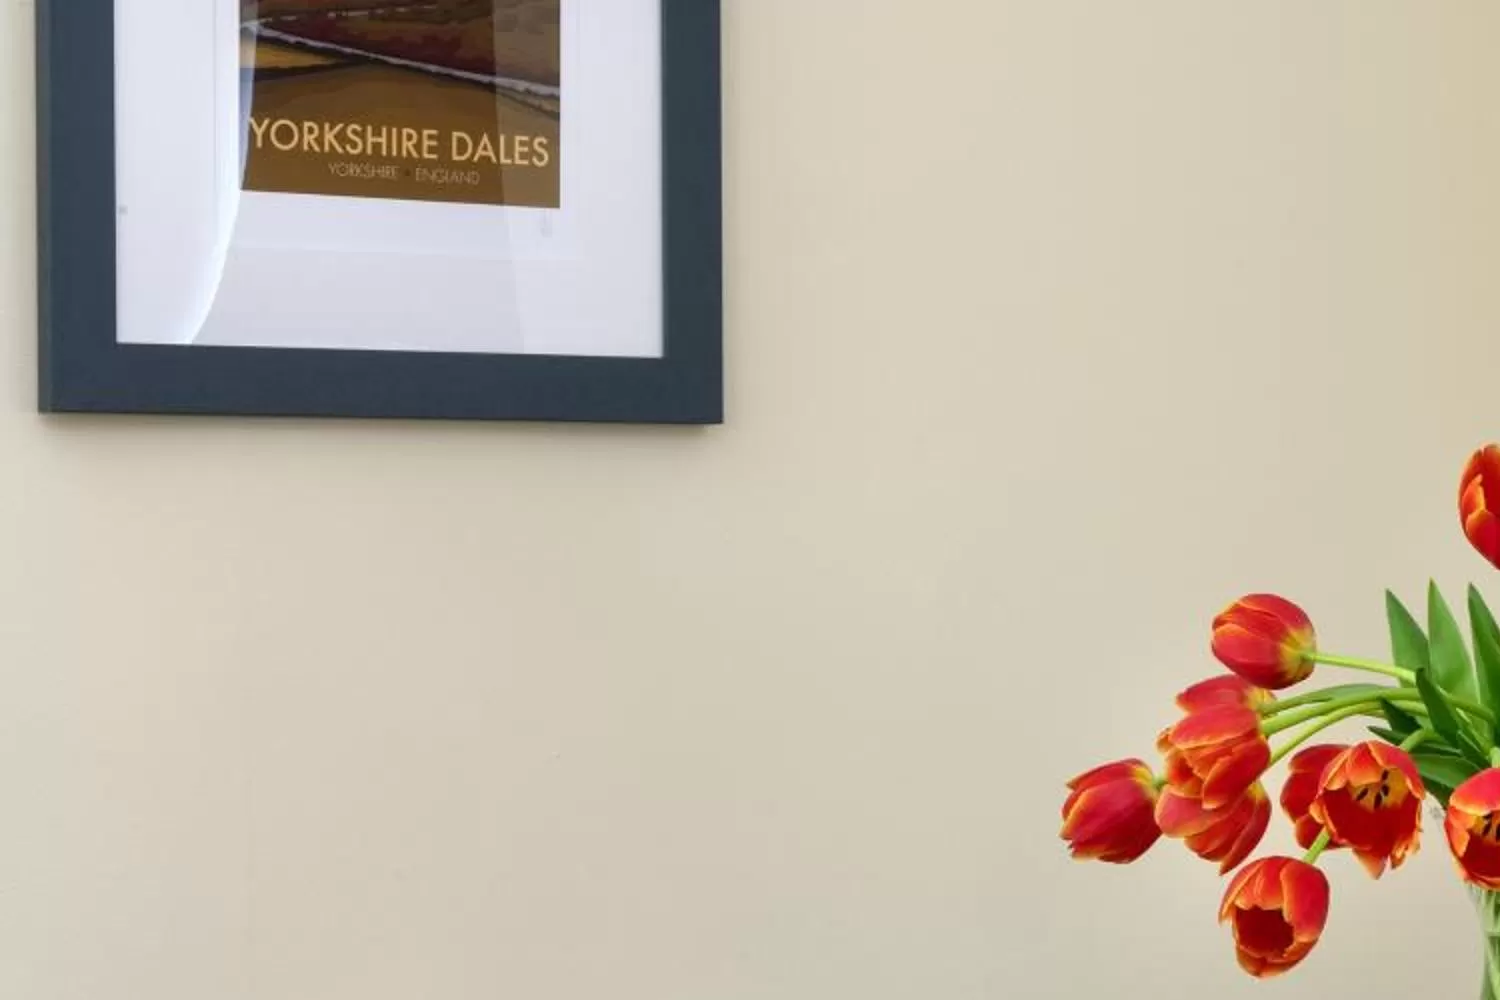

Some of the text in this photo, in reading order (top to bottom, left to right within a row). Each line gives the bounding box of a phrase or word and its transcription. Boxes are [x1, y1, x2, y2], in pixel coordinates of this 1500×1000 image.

[249, 117, 550, 168] YORKSHIRE DALES
[328, 162, 481, 186] YORKSHIRE ENGLAND
